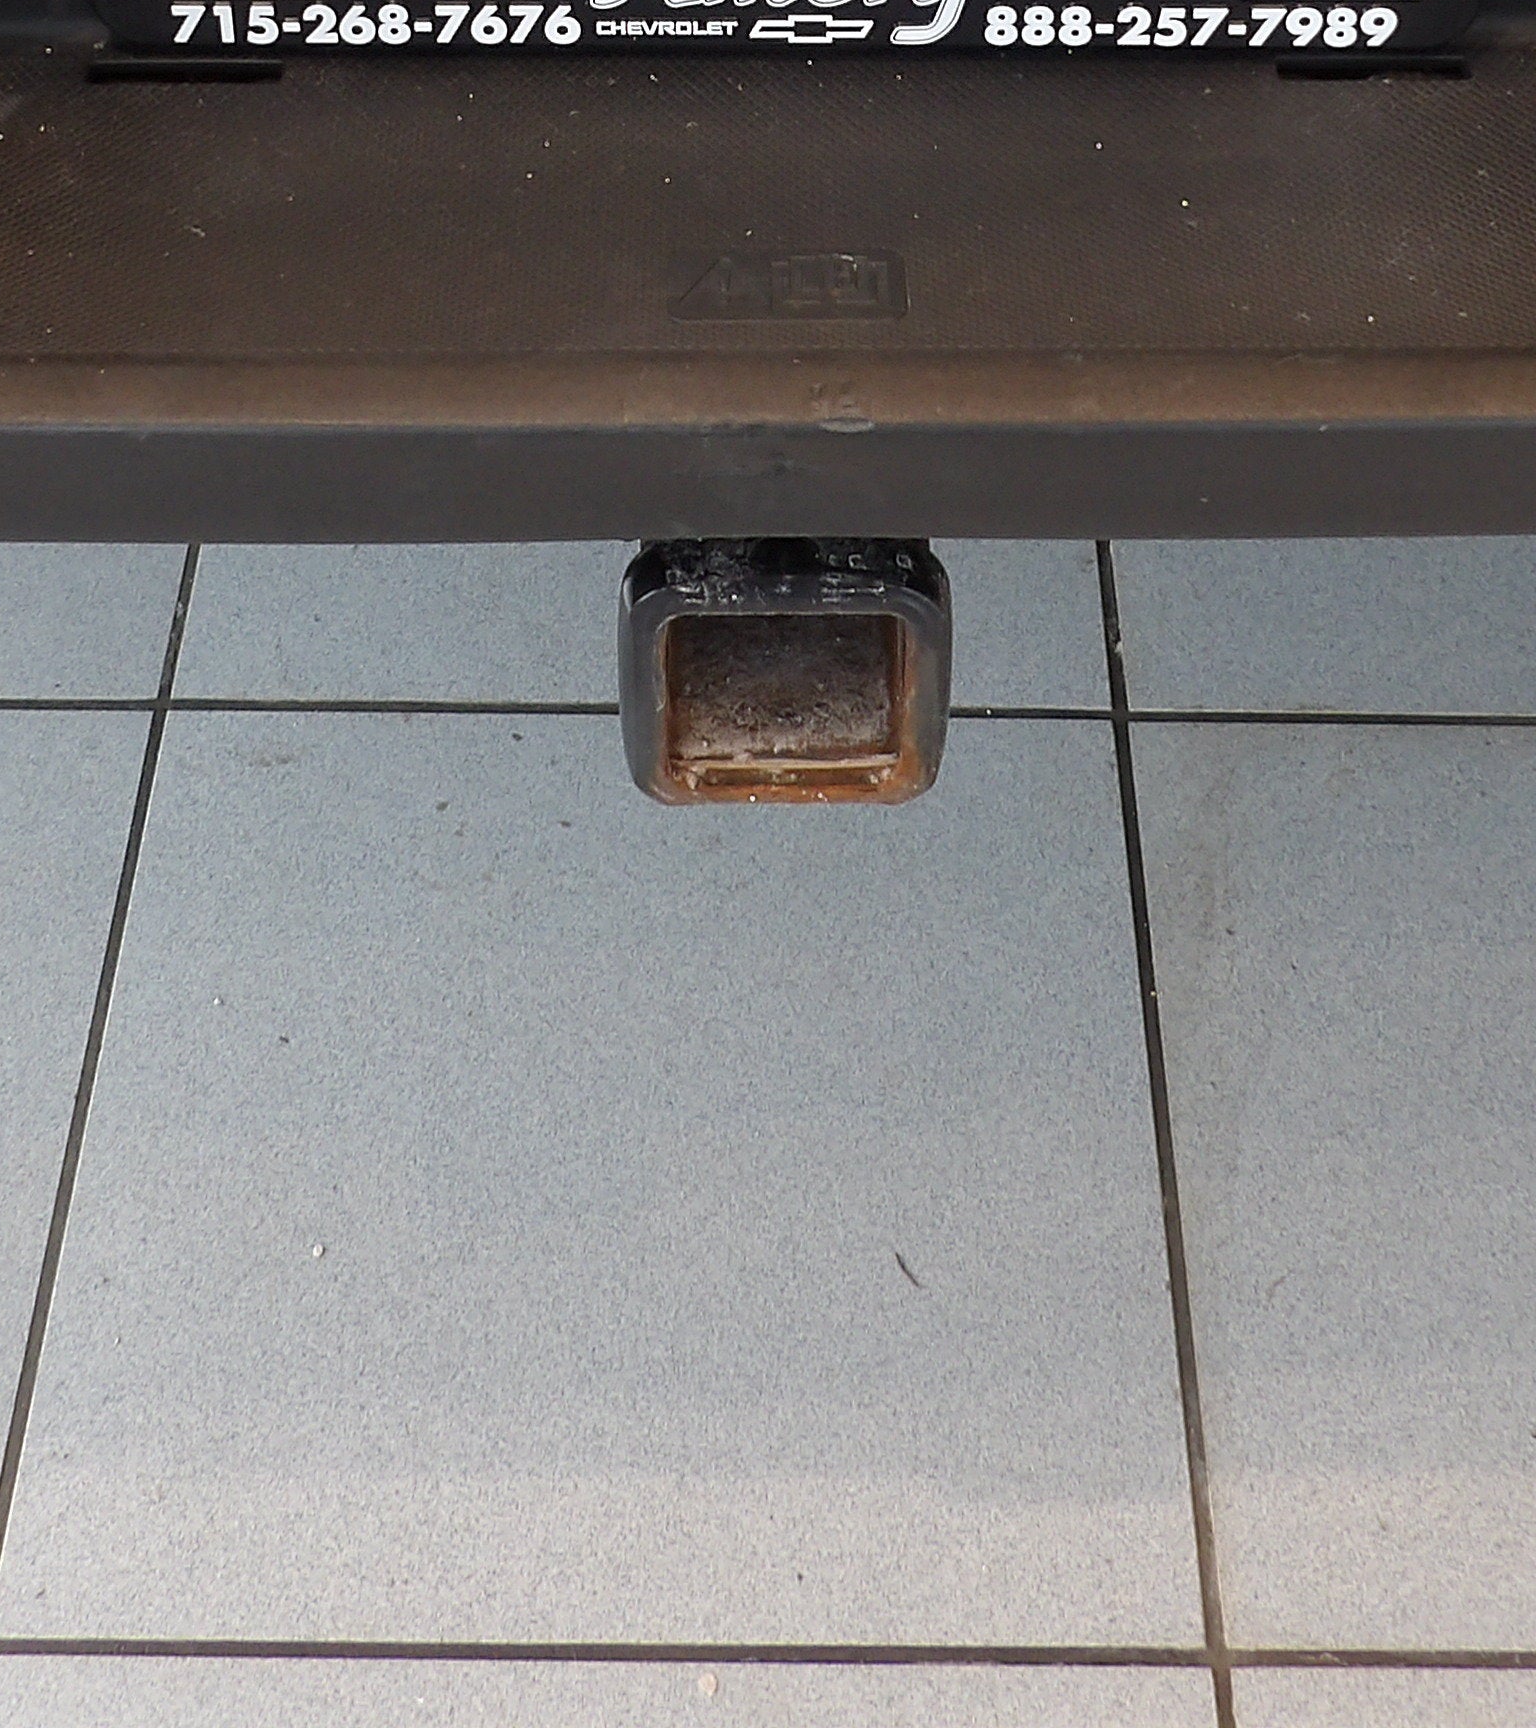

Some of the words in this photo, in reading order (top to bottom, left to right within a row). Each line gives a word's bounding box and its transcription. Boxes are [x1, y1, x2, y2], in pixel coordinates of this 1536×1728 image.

[170, 3, 582, 45] 715-268-7676
[595, 20, 739, 36] CHEVROLET
[984, 5, 1398, 48] 888-257-7989
